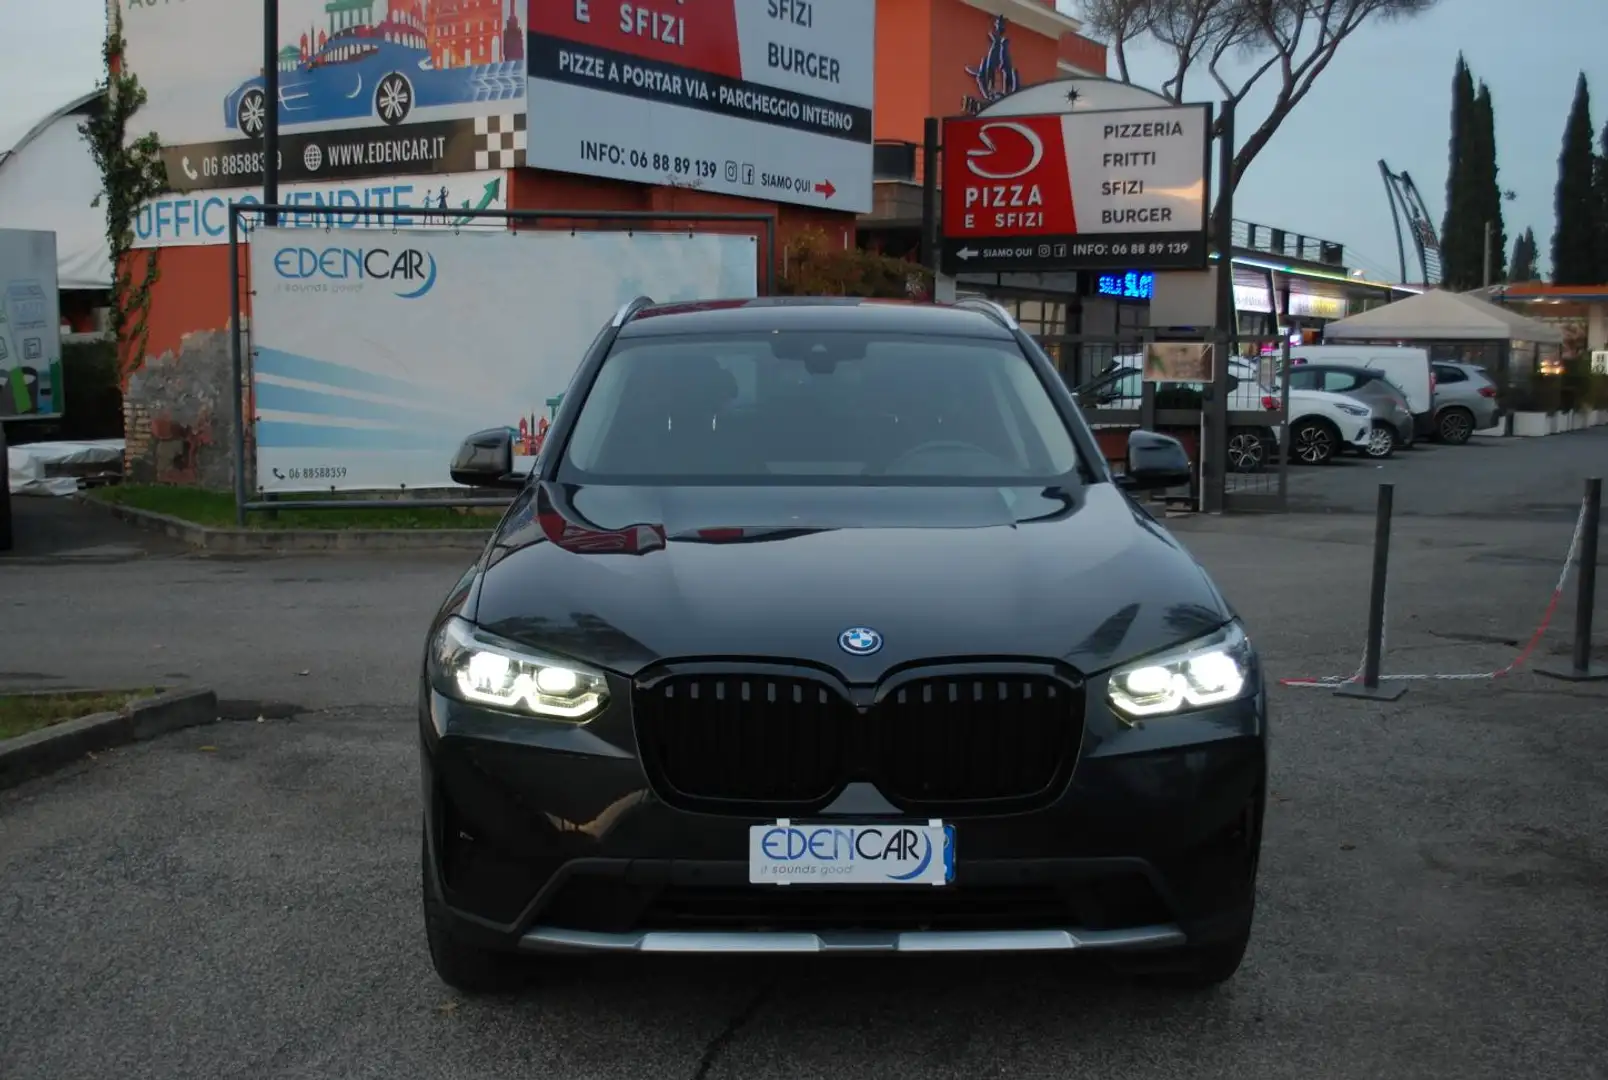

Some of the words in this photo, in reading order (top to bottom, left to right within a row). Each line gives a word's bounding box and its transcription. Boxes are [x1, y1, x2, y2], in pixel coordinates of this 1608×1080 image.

[620, 3, 684, 46] SFIZI
[767, 0, 812, 28] SFIZI
[768, 42, 840, 83] BURGER
[559, 50, 605, 79] PIZZE
[608, 62, 620, 83] A
[622, 65, 682, 95] PORTAR
[685, 78, 709, 100] VIA
[719, 86, 800, 119] PARCHEGGIO
[803, 104, 853, 131] INTERNO
[1103, 121, 1184, 140] PIZZERIA
[328, 137, 445, 166] WWW.EDENCAR.IT
[580, 140, 626, 166] INFO:
[630, 150, 648, 168] 06
[653, 153, 670, 171] 88
[674, 157, 691, 174] 89
[695, 160, 717, 178] 139
[1102, 152, 1156, 168] FRITTI
[203, 156, 218, 177] 06
[761, 173, 792, 190] SIAMO
[794, 178, 811, 194] QUI
[1102, 180, 1144, 196] SFIZI
[964, 184, 1043, 208] PIZZA
[964, 214, 975, 229] E
[995, 212, 1043, 228] SFIZI
[1102, 207, 1173, 224] BURGER
[983, 248, 1013, 258] SIAMO
[1015, 248, 1033, 258] QUI
[1072, 244, 1108, 256] INFO:
[1111, 244, 1127, 255] 06
[1130, 243, 1145, 254] 88
[1149, 243, 1164, 254] 89
[1168, 243, 1189, 254] 139
[274, 248, 426, 280] EDENCAR
[288, 467, 301, 479] 06
[761, 828, 920, 860] EDENCAR
[772, 864, 817, 875] sounds
